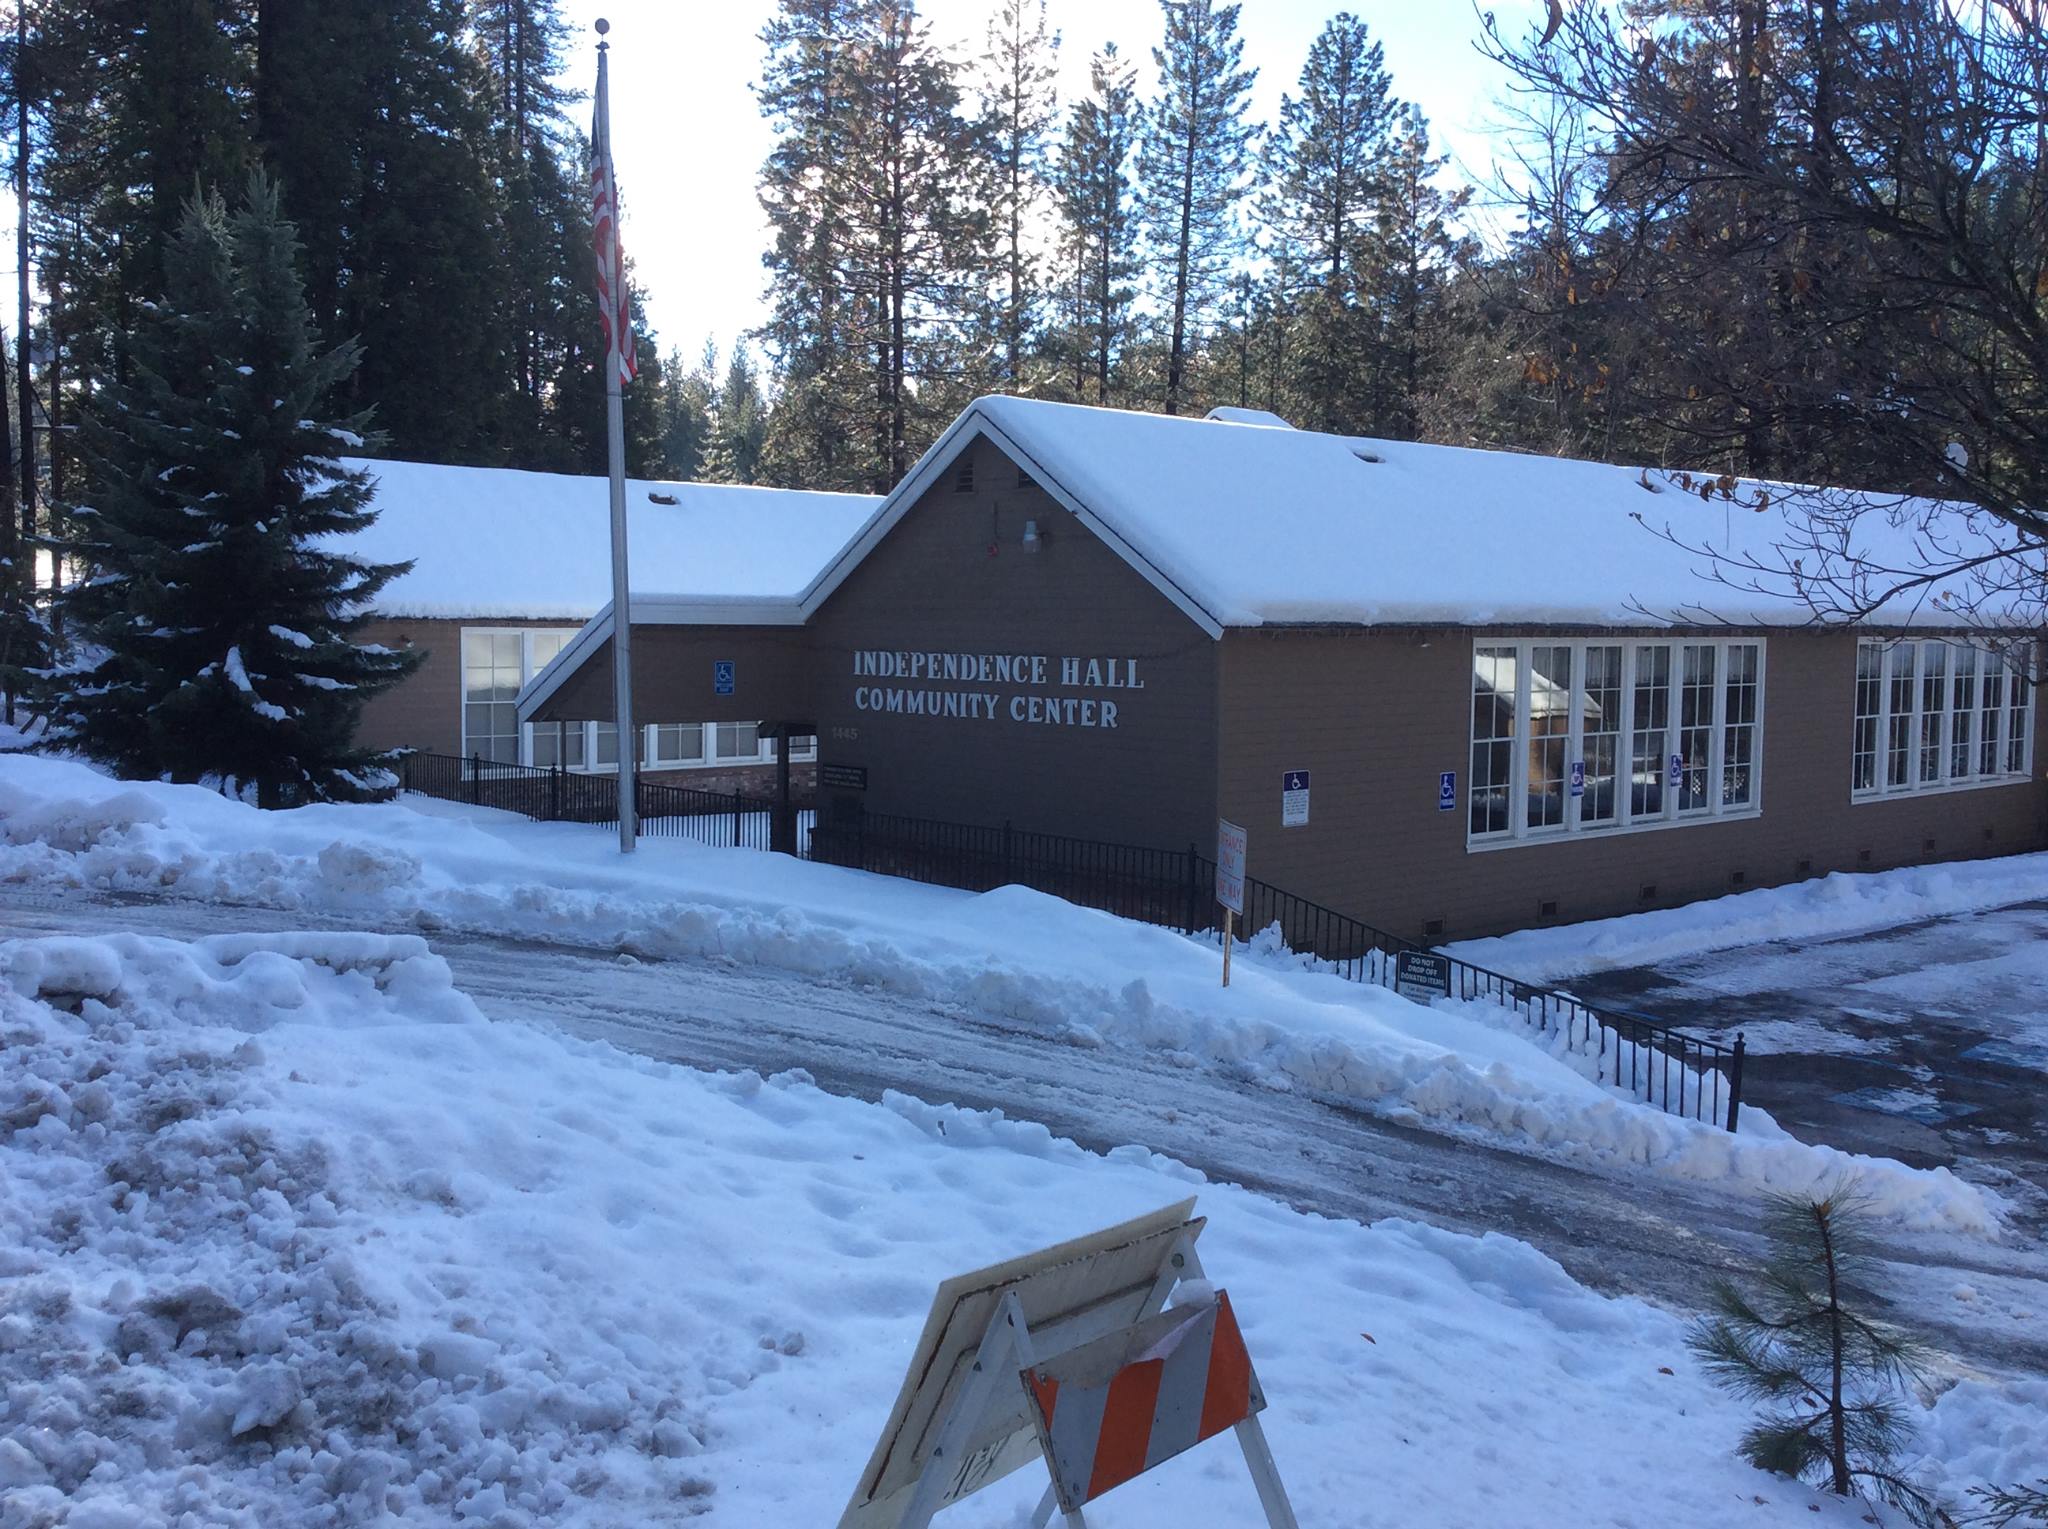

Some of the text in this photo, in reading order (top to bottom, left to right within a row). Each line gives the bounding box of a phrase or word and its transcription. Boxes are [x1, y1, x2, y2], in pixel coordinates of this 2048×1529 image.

[853, 650, 1145, 689] INDEPENDENCE HALL
[855, 686, 1119, 729] COMMUNITY CENTER
[832, 726, 859, 740] 1445
[1422, 959, 1435, 967] NOT
[1408, 964, 1438, 976] DROP OFF
[1401, 972, 1427, 983] DONATED
